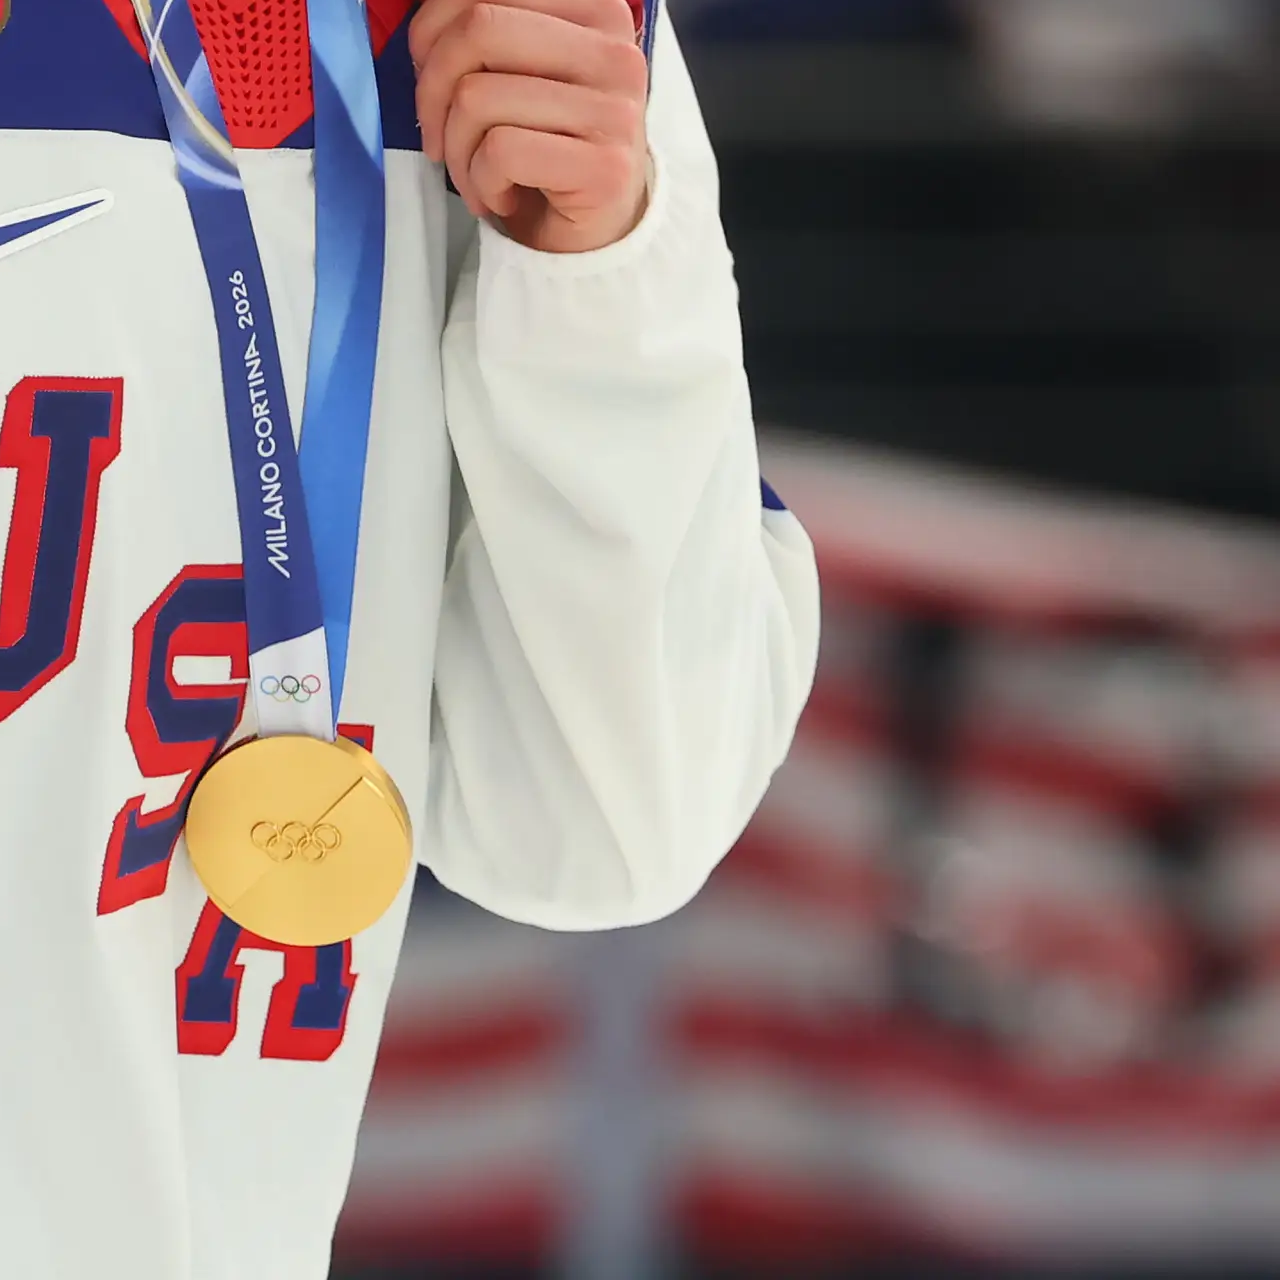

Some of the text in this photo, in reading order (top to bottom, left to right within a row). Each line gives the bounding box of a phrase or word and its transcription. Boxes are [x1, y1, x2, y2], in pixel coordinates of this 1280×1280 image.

[228, 269, 291, 579] MILANO CORTINA 2026
